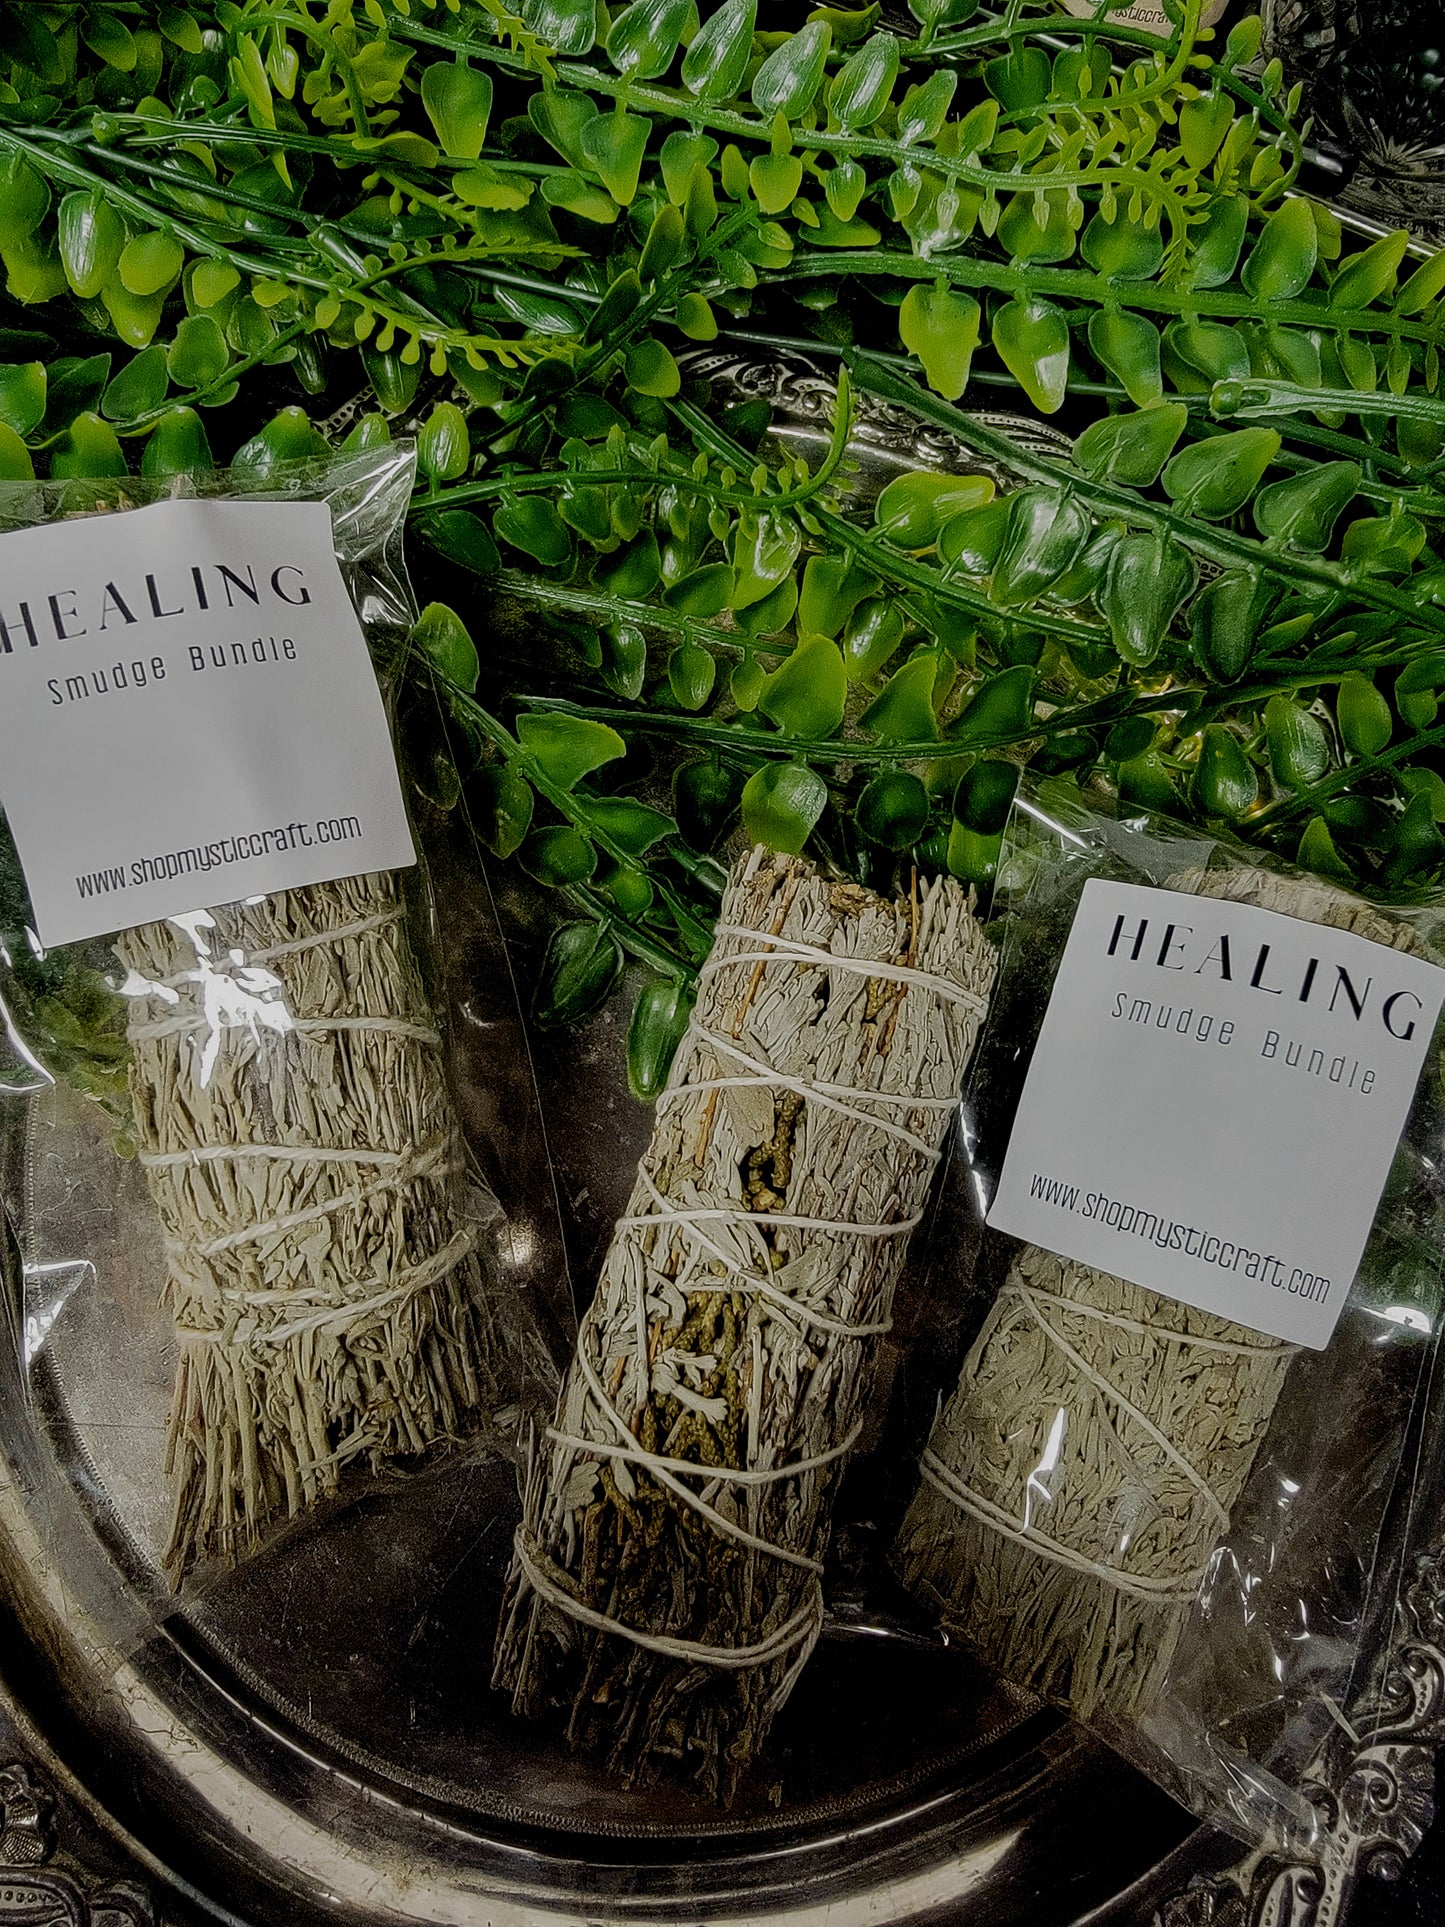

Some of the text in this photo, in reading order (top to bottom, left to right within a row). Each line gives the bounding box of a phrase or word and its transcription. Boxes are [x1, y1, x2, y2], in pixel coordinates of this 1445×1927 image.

[0, 564, 312, 654] HEALING
[47, 636, 298, 705] Smudge Bundle
[76, 815, 363, 899] www.shopmysticcraft.com
[1106, 914, 1424, 1042] HEALING
[1111, 992, 1377, 1095] Smudge Bundle
[1029, 1173, 1332, 1305] www.shopmysticcraft.com
